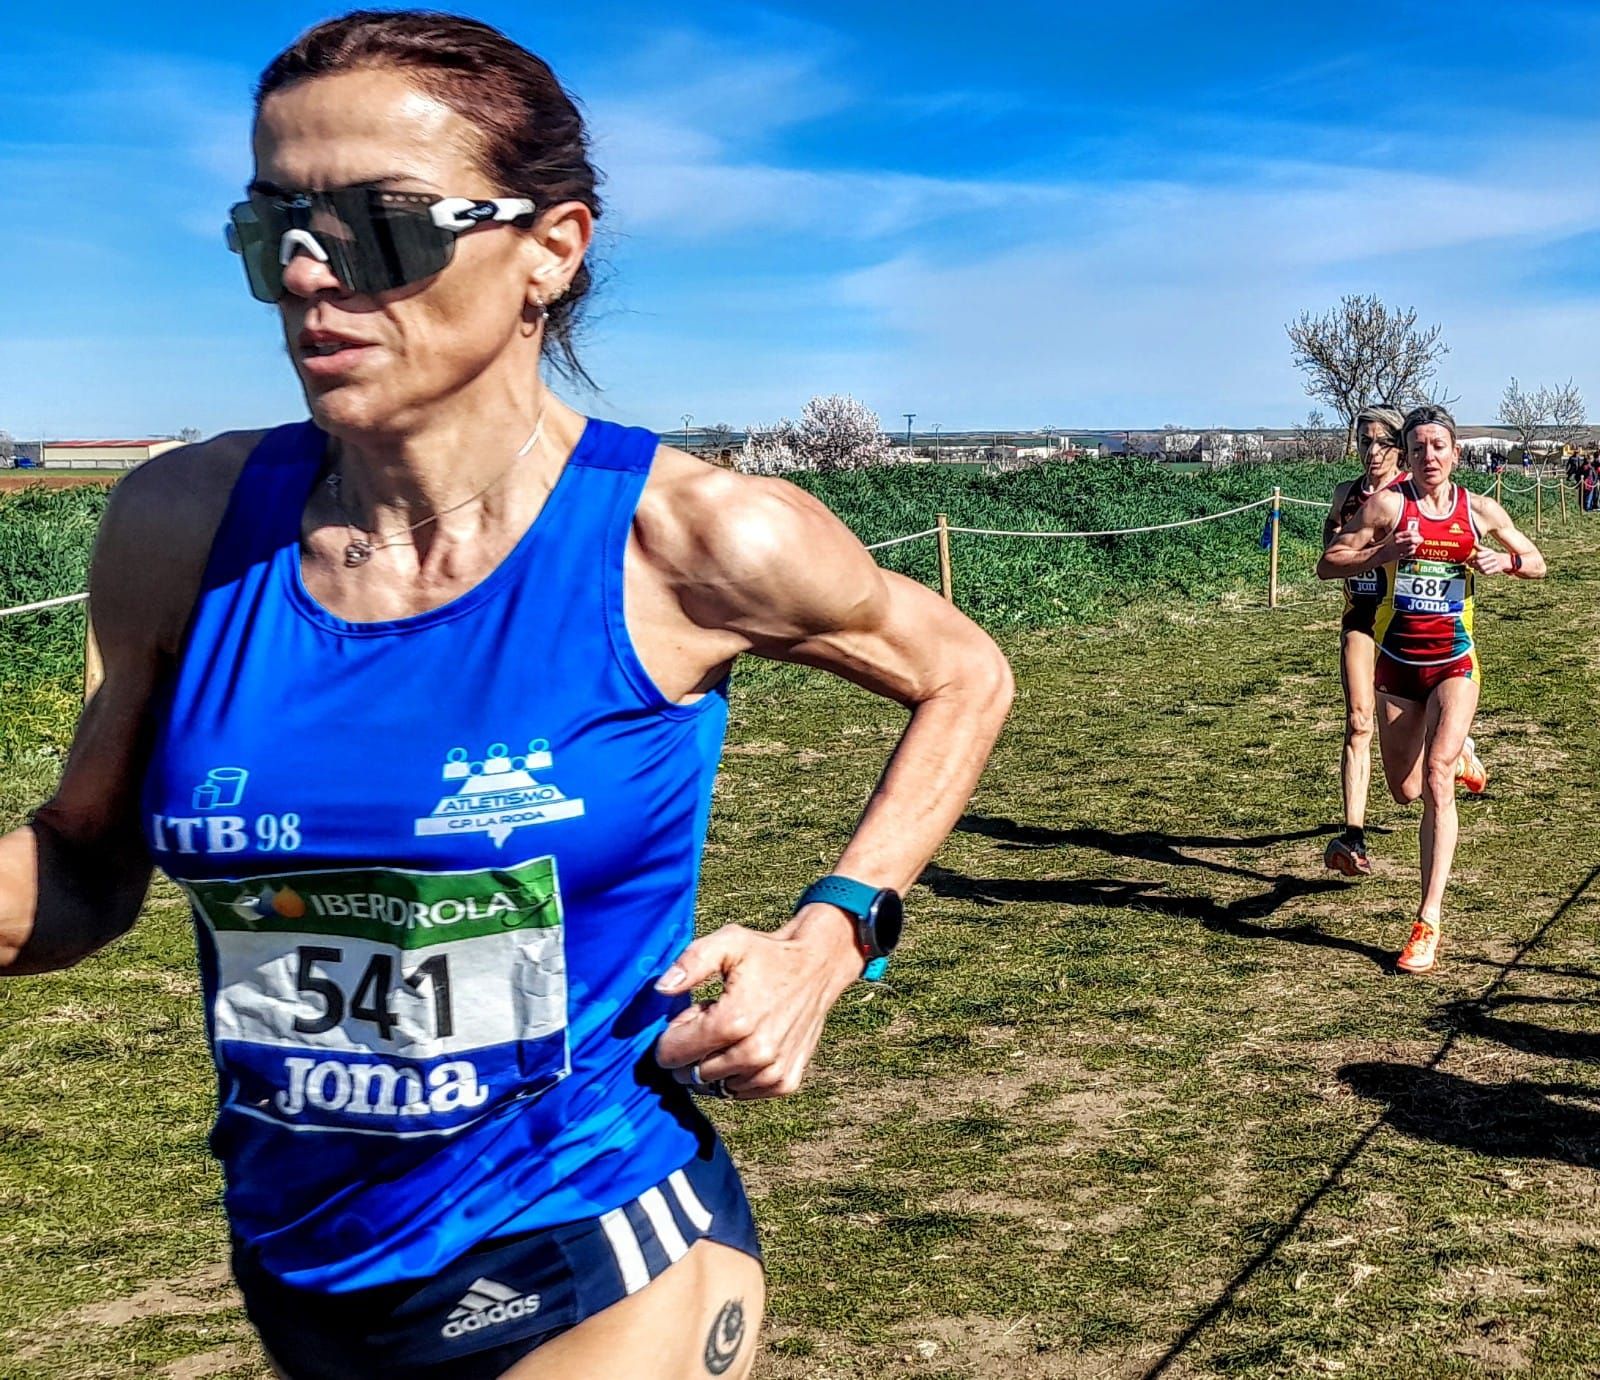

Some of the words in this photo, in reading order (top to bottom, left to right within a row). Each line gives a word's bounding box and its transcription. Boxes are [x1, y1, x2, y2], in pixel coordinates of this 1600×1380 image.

[1421, 548, 1449, 557] VINO
[1412, 577, 1452, 597] 687
[443, 788, 554, 812] ATLETISMO
[255, 812, 301, 851] 98
[476, 817, 495, 828] LA
[499, 811, 546, 824] RODA
[310, 892, 520, 930] IBERDROLA
[293, 945, 455, 1040] 541
[441, 1293, 542, 1339] adidas
